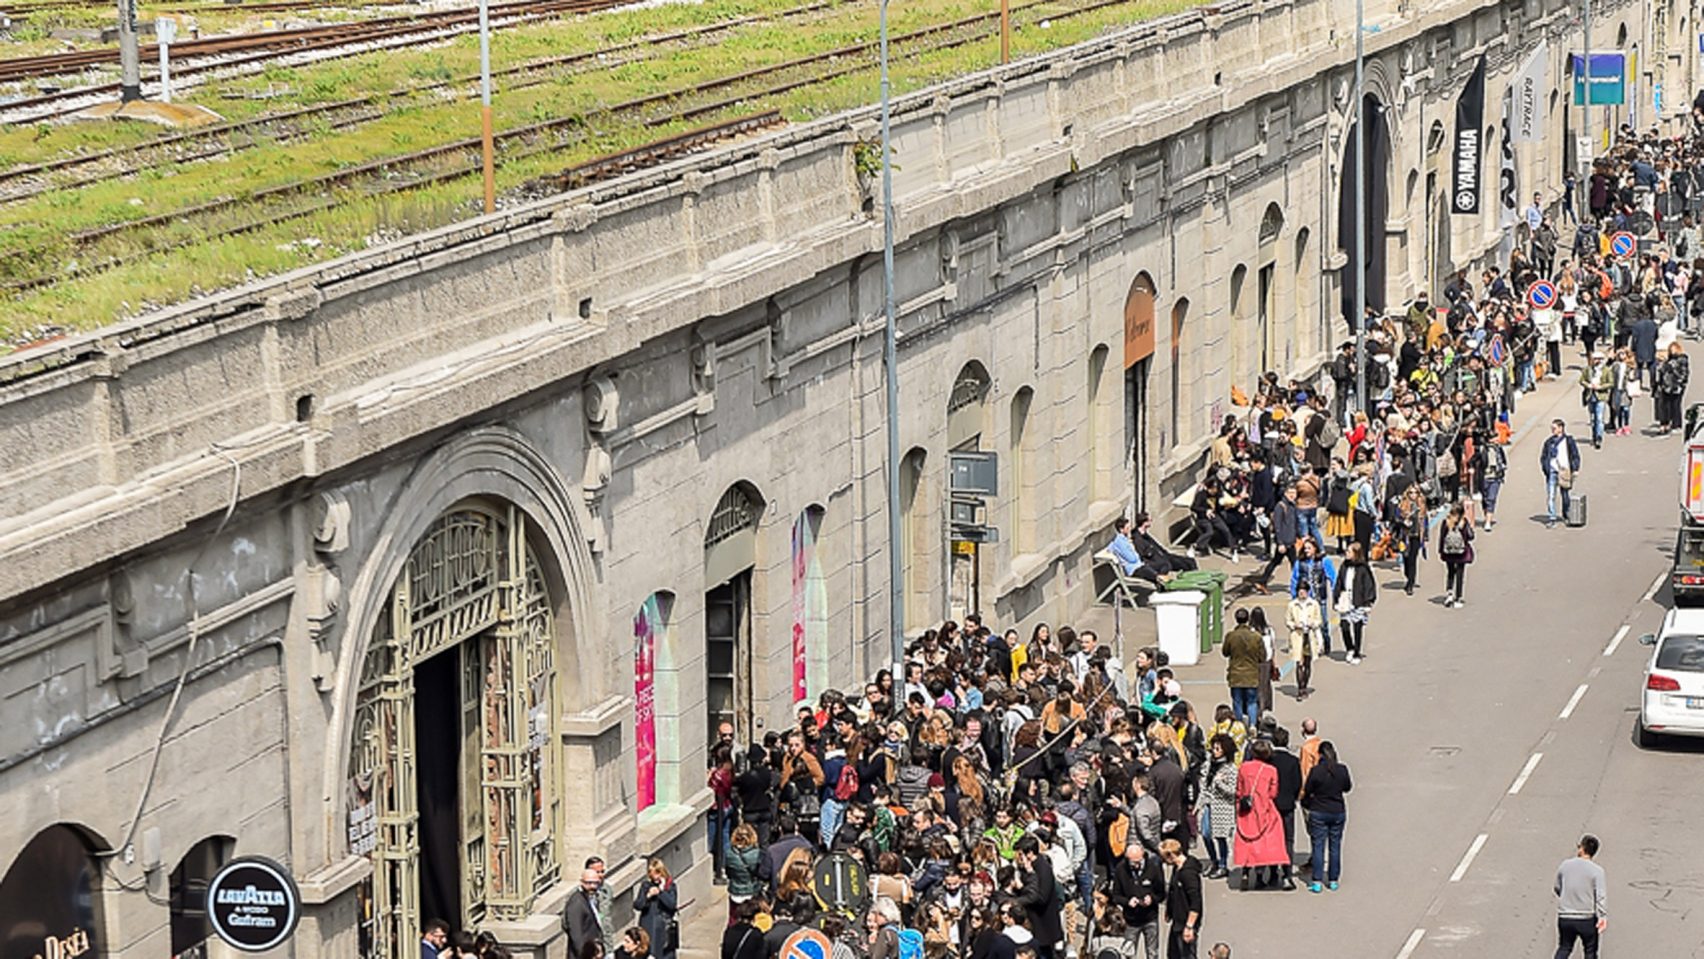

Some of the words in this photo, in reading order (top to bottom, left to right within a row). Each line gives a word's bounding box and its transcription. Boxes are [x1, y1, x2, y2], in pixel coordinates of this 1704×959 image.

[1522, 77, 1534, 138] RAYTRACE
[1457, 128, 1479, 191] YAMAHA
[217, 884, 286, 906] LAVAZZA
